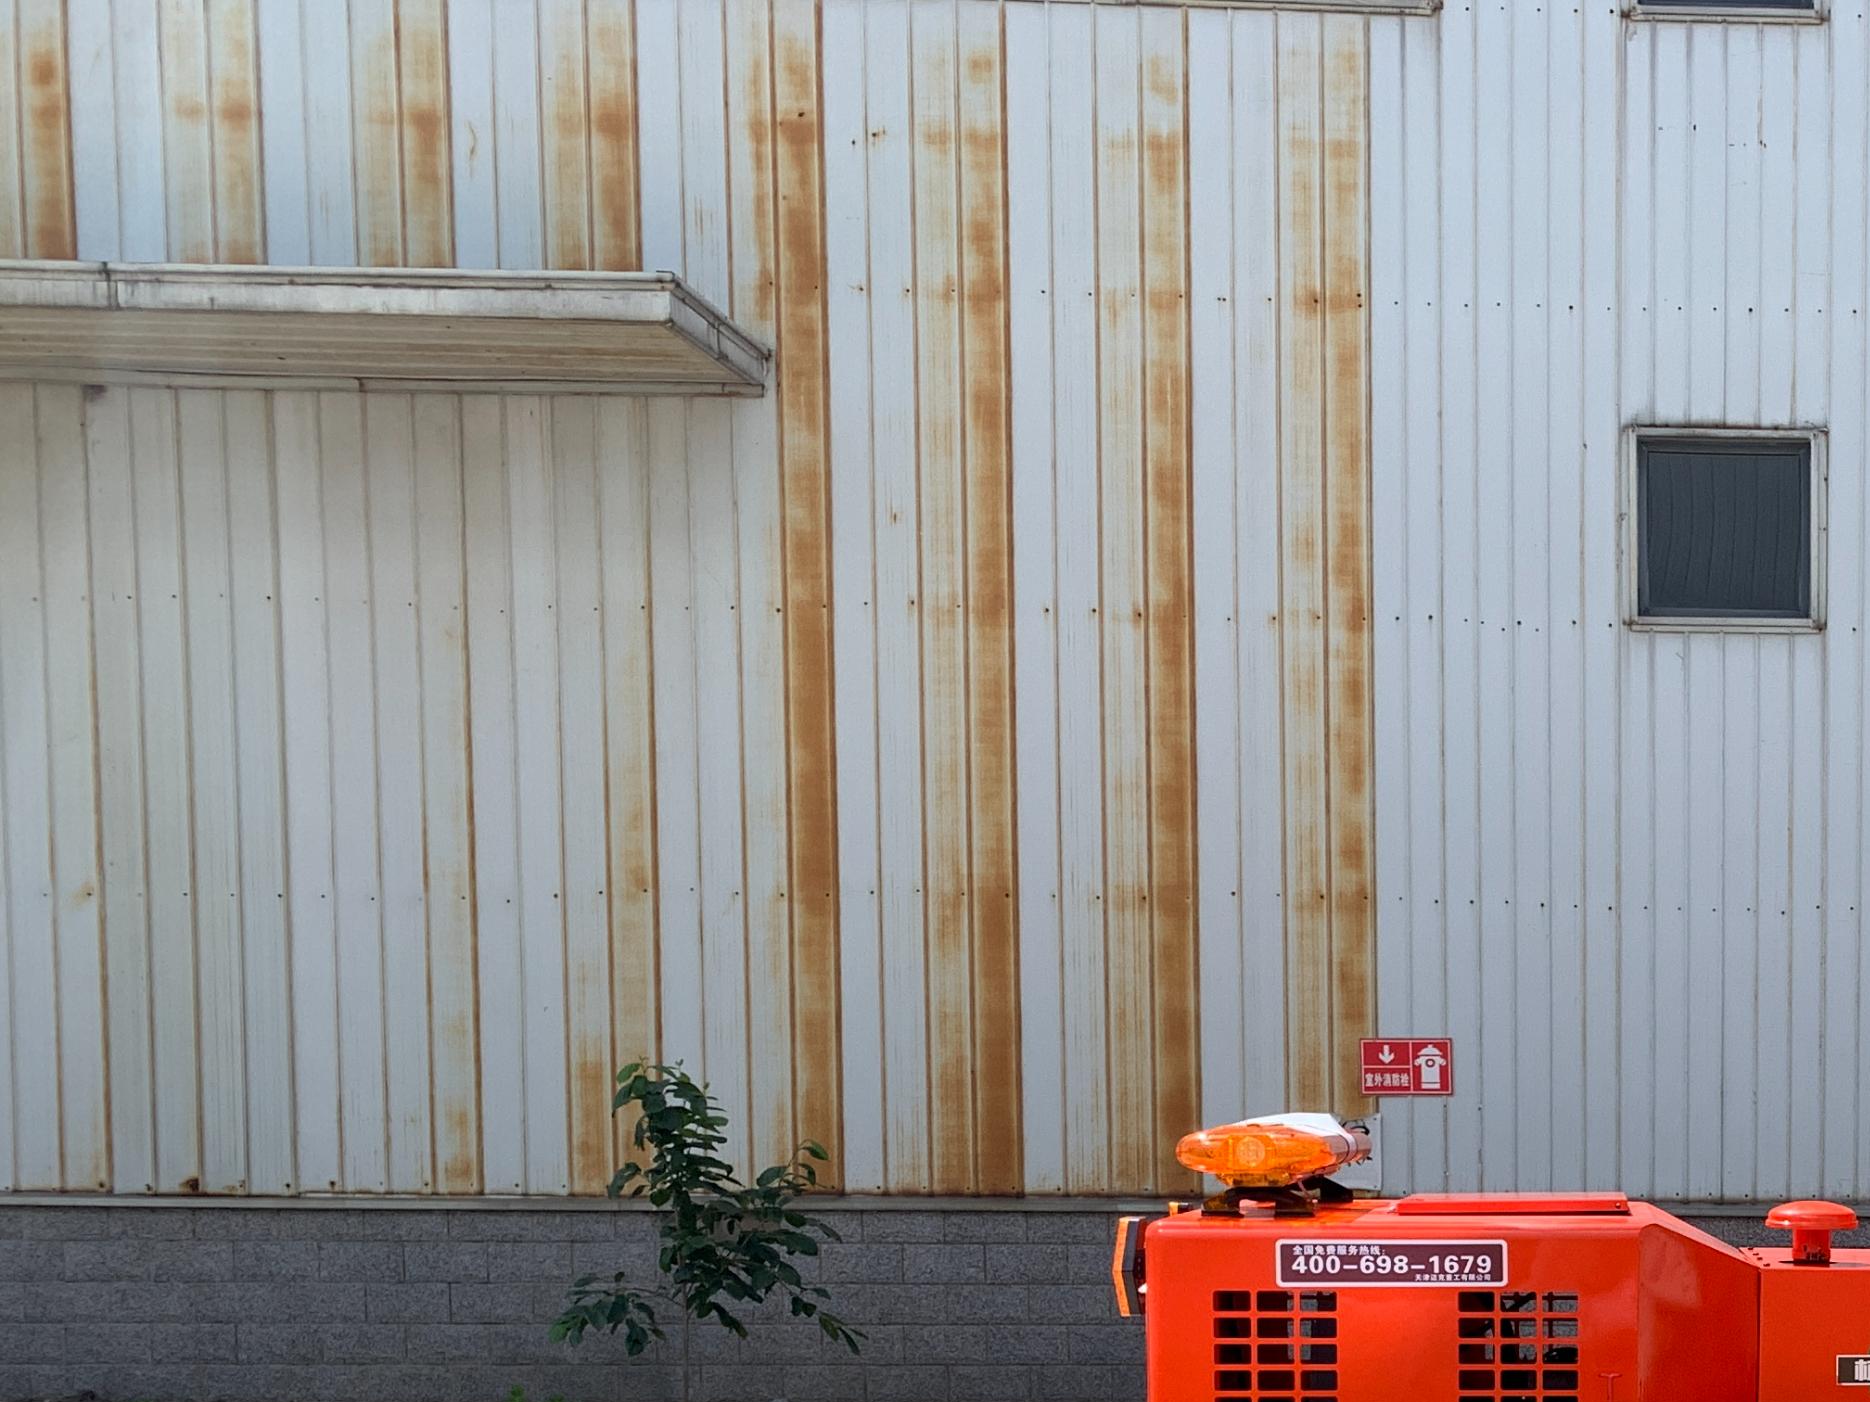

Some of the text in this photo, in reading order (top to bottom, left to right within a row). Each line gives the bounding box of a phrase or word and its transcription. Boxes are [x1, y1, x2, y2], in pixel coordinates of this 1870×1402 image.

[1365, 1072, 1409, 1087] 室外消防栓
[1291, 1255, 1492, 1274] 400-698-1679
